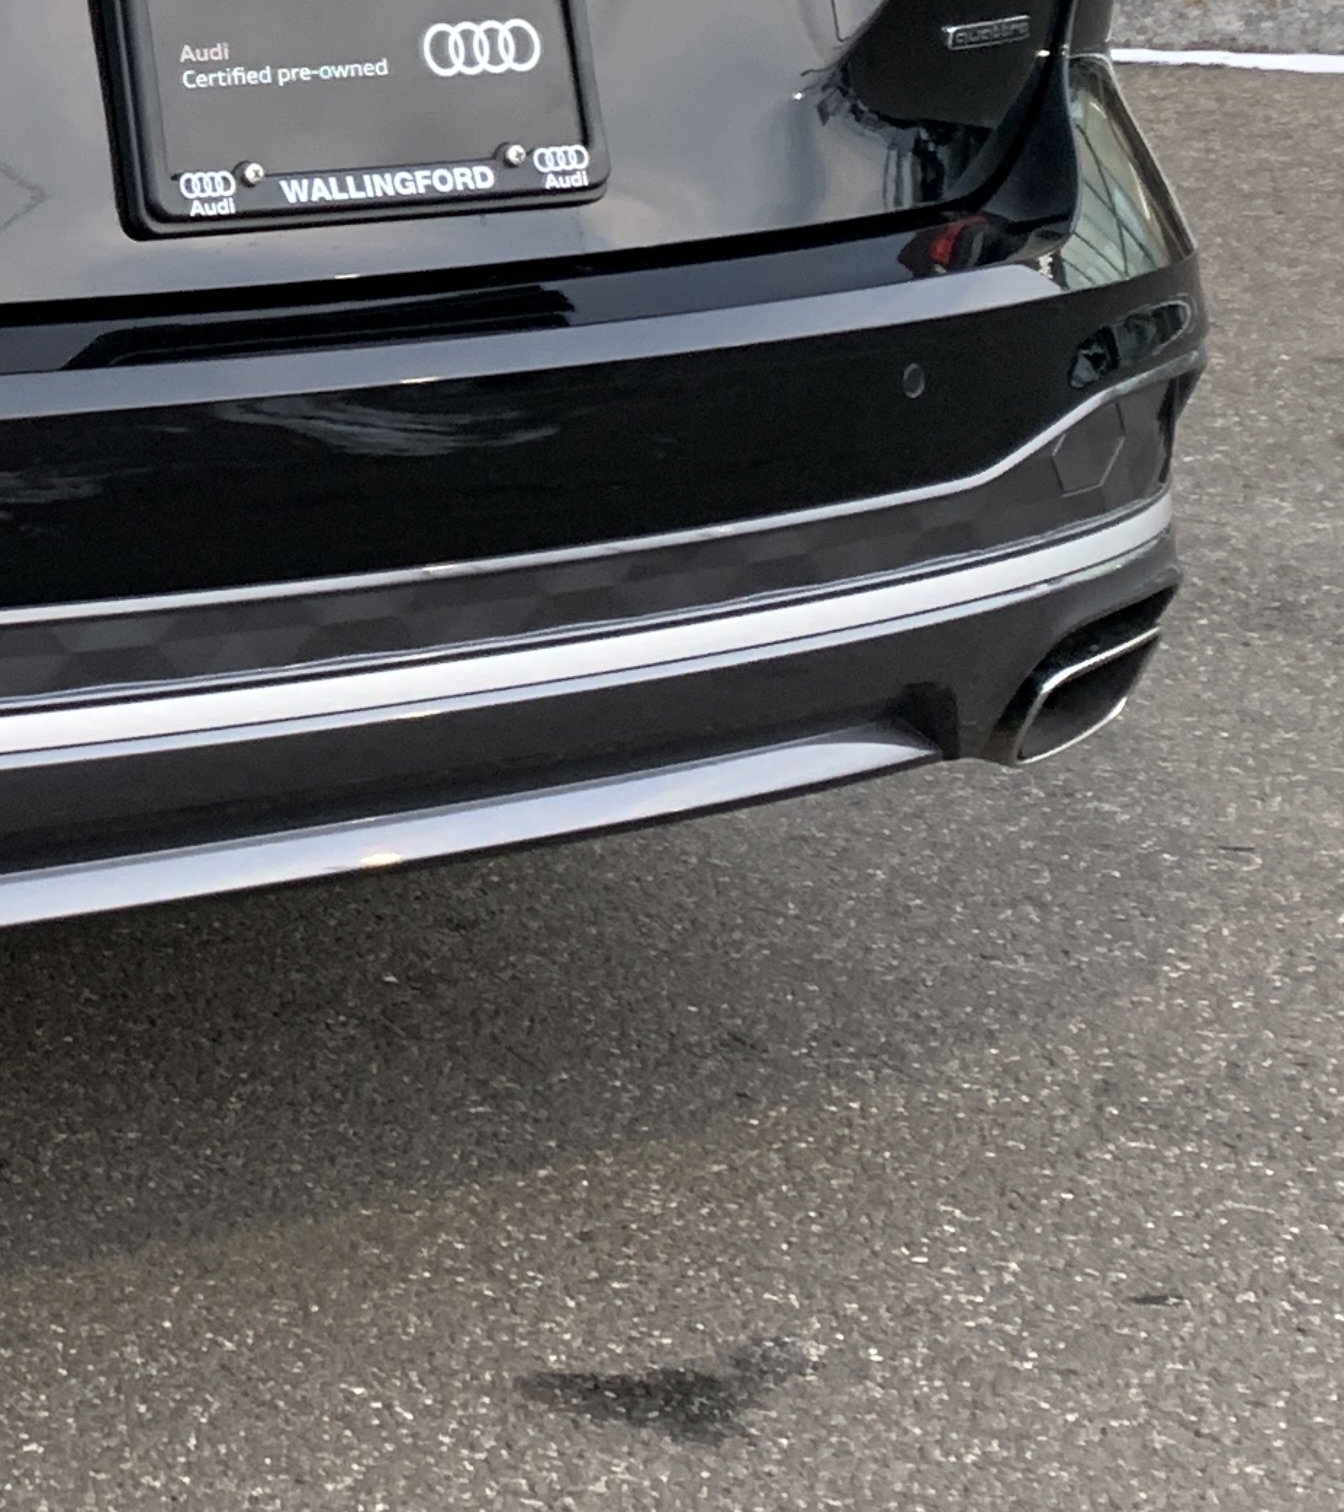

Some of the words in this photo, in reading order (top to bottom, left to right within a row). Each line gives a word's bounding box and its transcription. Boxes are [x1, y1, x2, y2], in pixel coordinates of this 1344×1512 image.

[179, 42, 230, 63] Audi
[182, 65, 272, 88] Certified
[277, 58, 389, 87] pre-owned
[278, 165, 495, 204] WALLINGFORD
[544, 171, 589, 190] Audi
[189, 197, 236, 217] Audi
